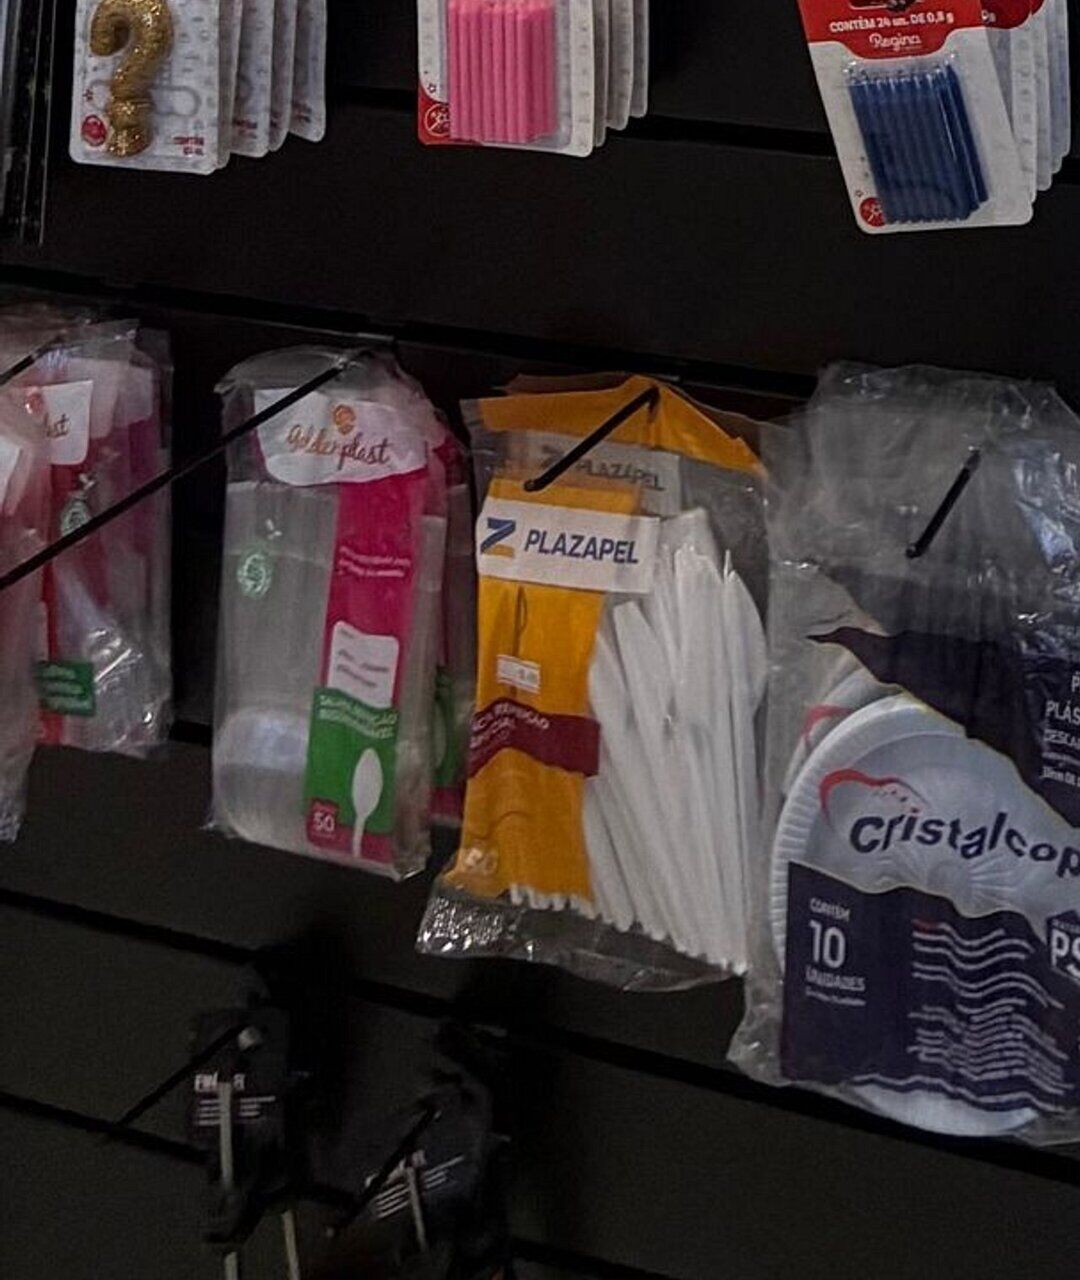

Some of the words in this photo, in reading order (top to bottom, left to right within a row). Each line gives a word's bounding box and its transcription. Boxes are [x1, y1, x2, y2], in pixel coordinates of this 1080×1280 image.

[829, 15, 876, 33] CONTÉM
[877, 16, 892, 29] 24
[910, 13, 925, 24] DE
[869, 32, 922, 52] Regina
[525, 528, 640, 565] PLAZAPEL
[809, 919, 846, 969] 10
